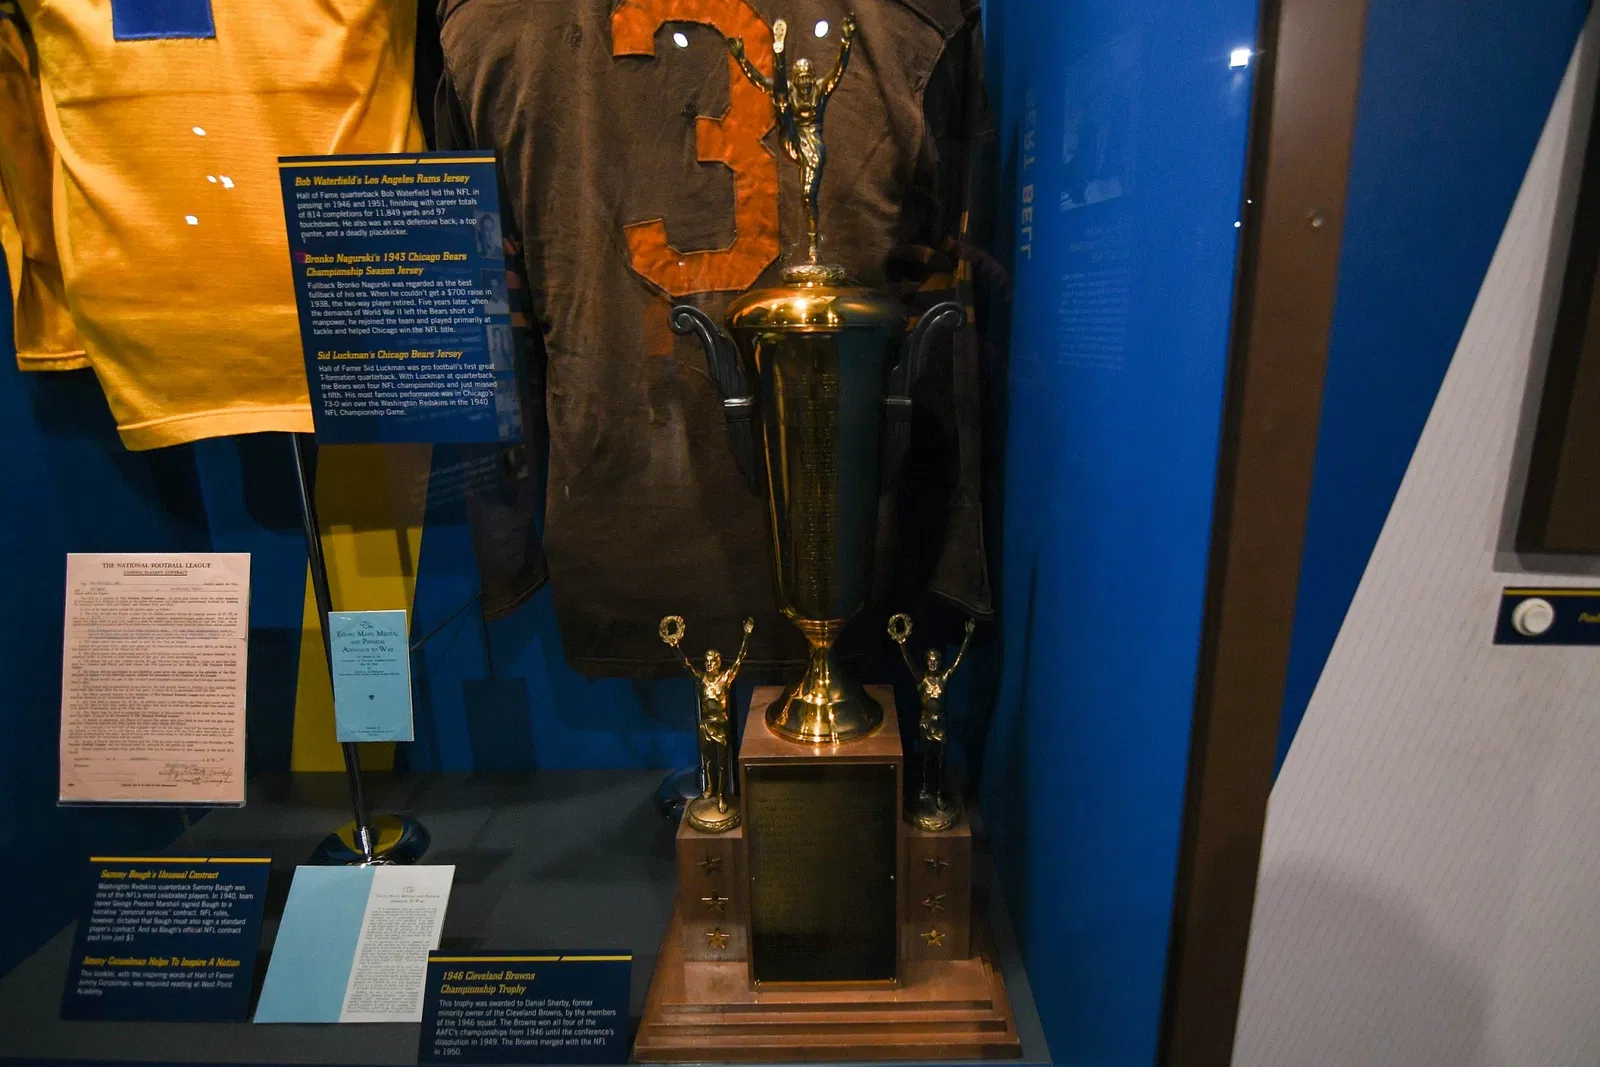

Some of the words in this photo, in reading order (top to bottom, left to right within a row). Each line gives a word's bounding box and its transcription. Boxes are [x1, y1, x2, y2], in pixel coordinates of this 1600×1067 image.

[611, 0, 780, 297] 3
[295, 176, 311, 186] Bob
[313, 175, 362, 185] Waterfield's
[364, 175, 379, 184] Los
[381, 174, 414, 185] Angeles
[416, 173, 441, 183] Rams
[443, 172, 469, 184] Jersey
[340, 190, 379, 199] quarterback
[396, 188, 429, 196] Waterfield
[390, 199, 418, 208] finishing
[322, 209, 362, 218] completions
[402, 208, 420, 217] yards
[436, 207, 446, 215] 97
[406, 217, 438, 225] defensive
[466, 217, 477, 225] top
[346, 228, 367, 237] deadly
[305, 253, 334, 263] Bronko
[336, 252, 380, 264] Nagurski's
[383, 252, 406, 261] 1943
[408, 251, 441, 263] Chicago
[442, 251, 467, 260] Bears
[306, 266, 364, 277] Championship
[365, 265, 395, 275] Season
[397, 265, 423, 276] Jersey
[362, 280, 390, 289] Nagurski
[406, 279, 434, 288] regarded
[317, 350, 331, 359] Sid
[332, 350, 375, 359] Luckman's
[377, 350, 409, 360] Chicago
[411, 349, 434, 358] Bears
[437, 348, 462, 359] Jersey
[478, 363, 494, 371] great
[443, 971, 464, 980] 1946
[465, 970, 503, 980] Cleveland
[505, 970, 535, 980] Browns
[440, 984, 496, 995] Championship
[498, 983, 526, 995] Trophy
[454, 1000, 474, 1008] trophy
[438, 1010, 464, 1018] minority
[565, 1009, 573, 1017] by
[459, 1028, 508, 1037] championships
